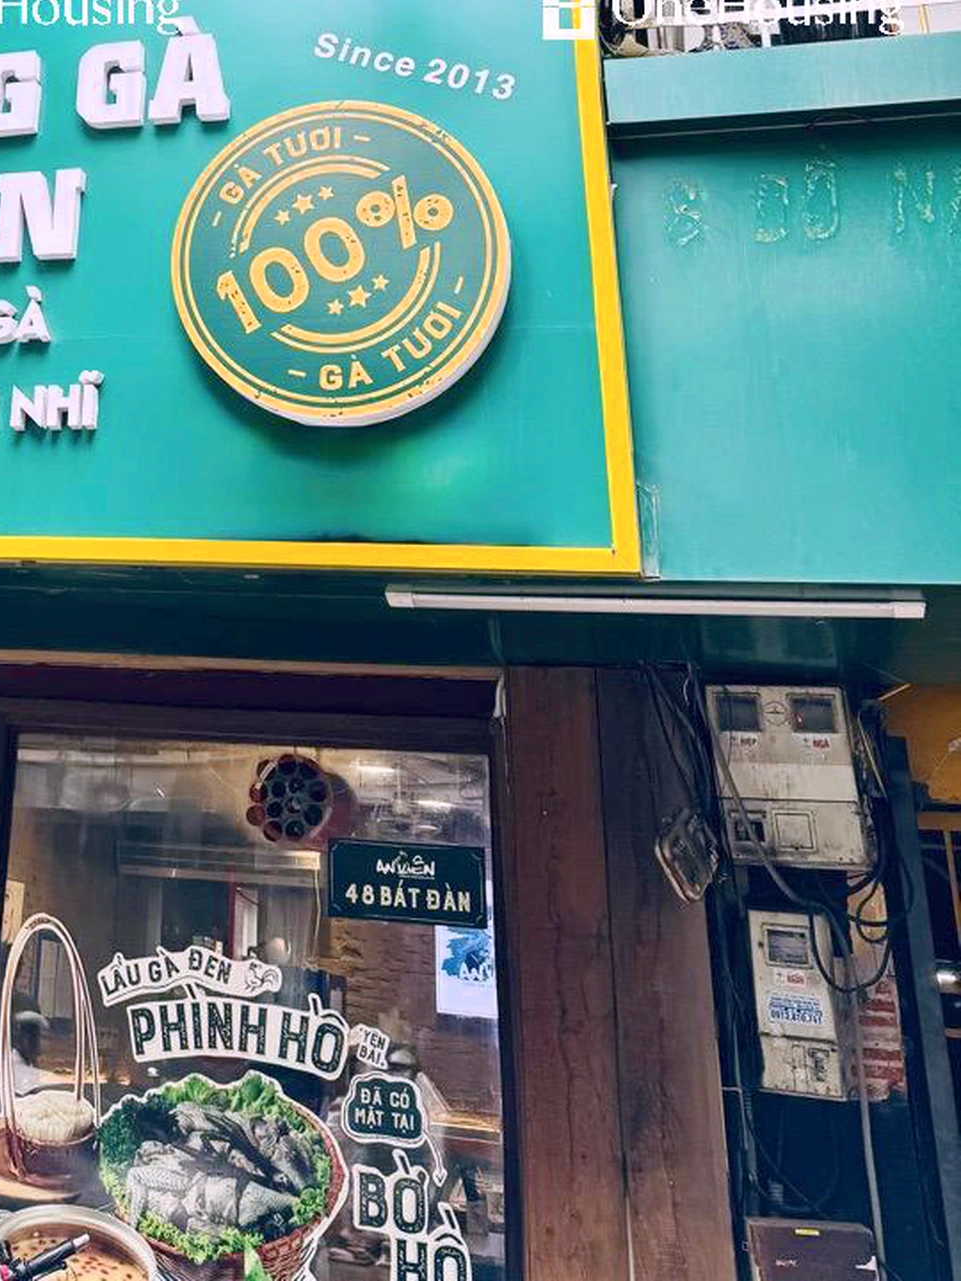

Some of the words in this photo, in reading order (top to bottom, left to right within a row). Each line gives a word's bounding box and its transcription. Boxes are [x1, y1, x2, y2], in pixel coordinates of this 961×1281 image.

[76, 17, 230, 130] GÀ
[314, 32, 415, 77] Since
[423, 57, 515, 100] 2013
[219, 163, 262, 205] GÀ
[216, 174, 454, 334] 100%
[319, 354, 373, 390] GÀ
[376, 859, 395, 875] AN
[345, 883, 374, 905] 48
[380, 880, 420, 908] BÁT
[426, 883, 471, 912] ĐÀN
[148, 949, 180, 983] GÀ
[188, 948, 232, 984] ĐEN
[130, 984, 268, 1055] PHÌNH
[278, 997, 349, 1072] HỒ
[361, 1085, 382, 1106] ĐÃ
[389, 1087, 410, 1109] CÓ
[354, 1105, 384, 1130] MẶT
[392, 1111, 415, 1133] TẠI
[359, 1151, 427, 1234] BỜ
